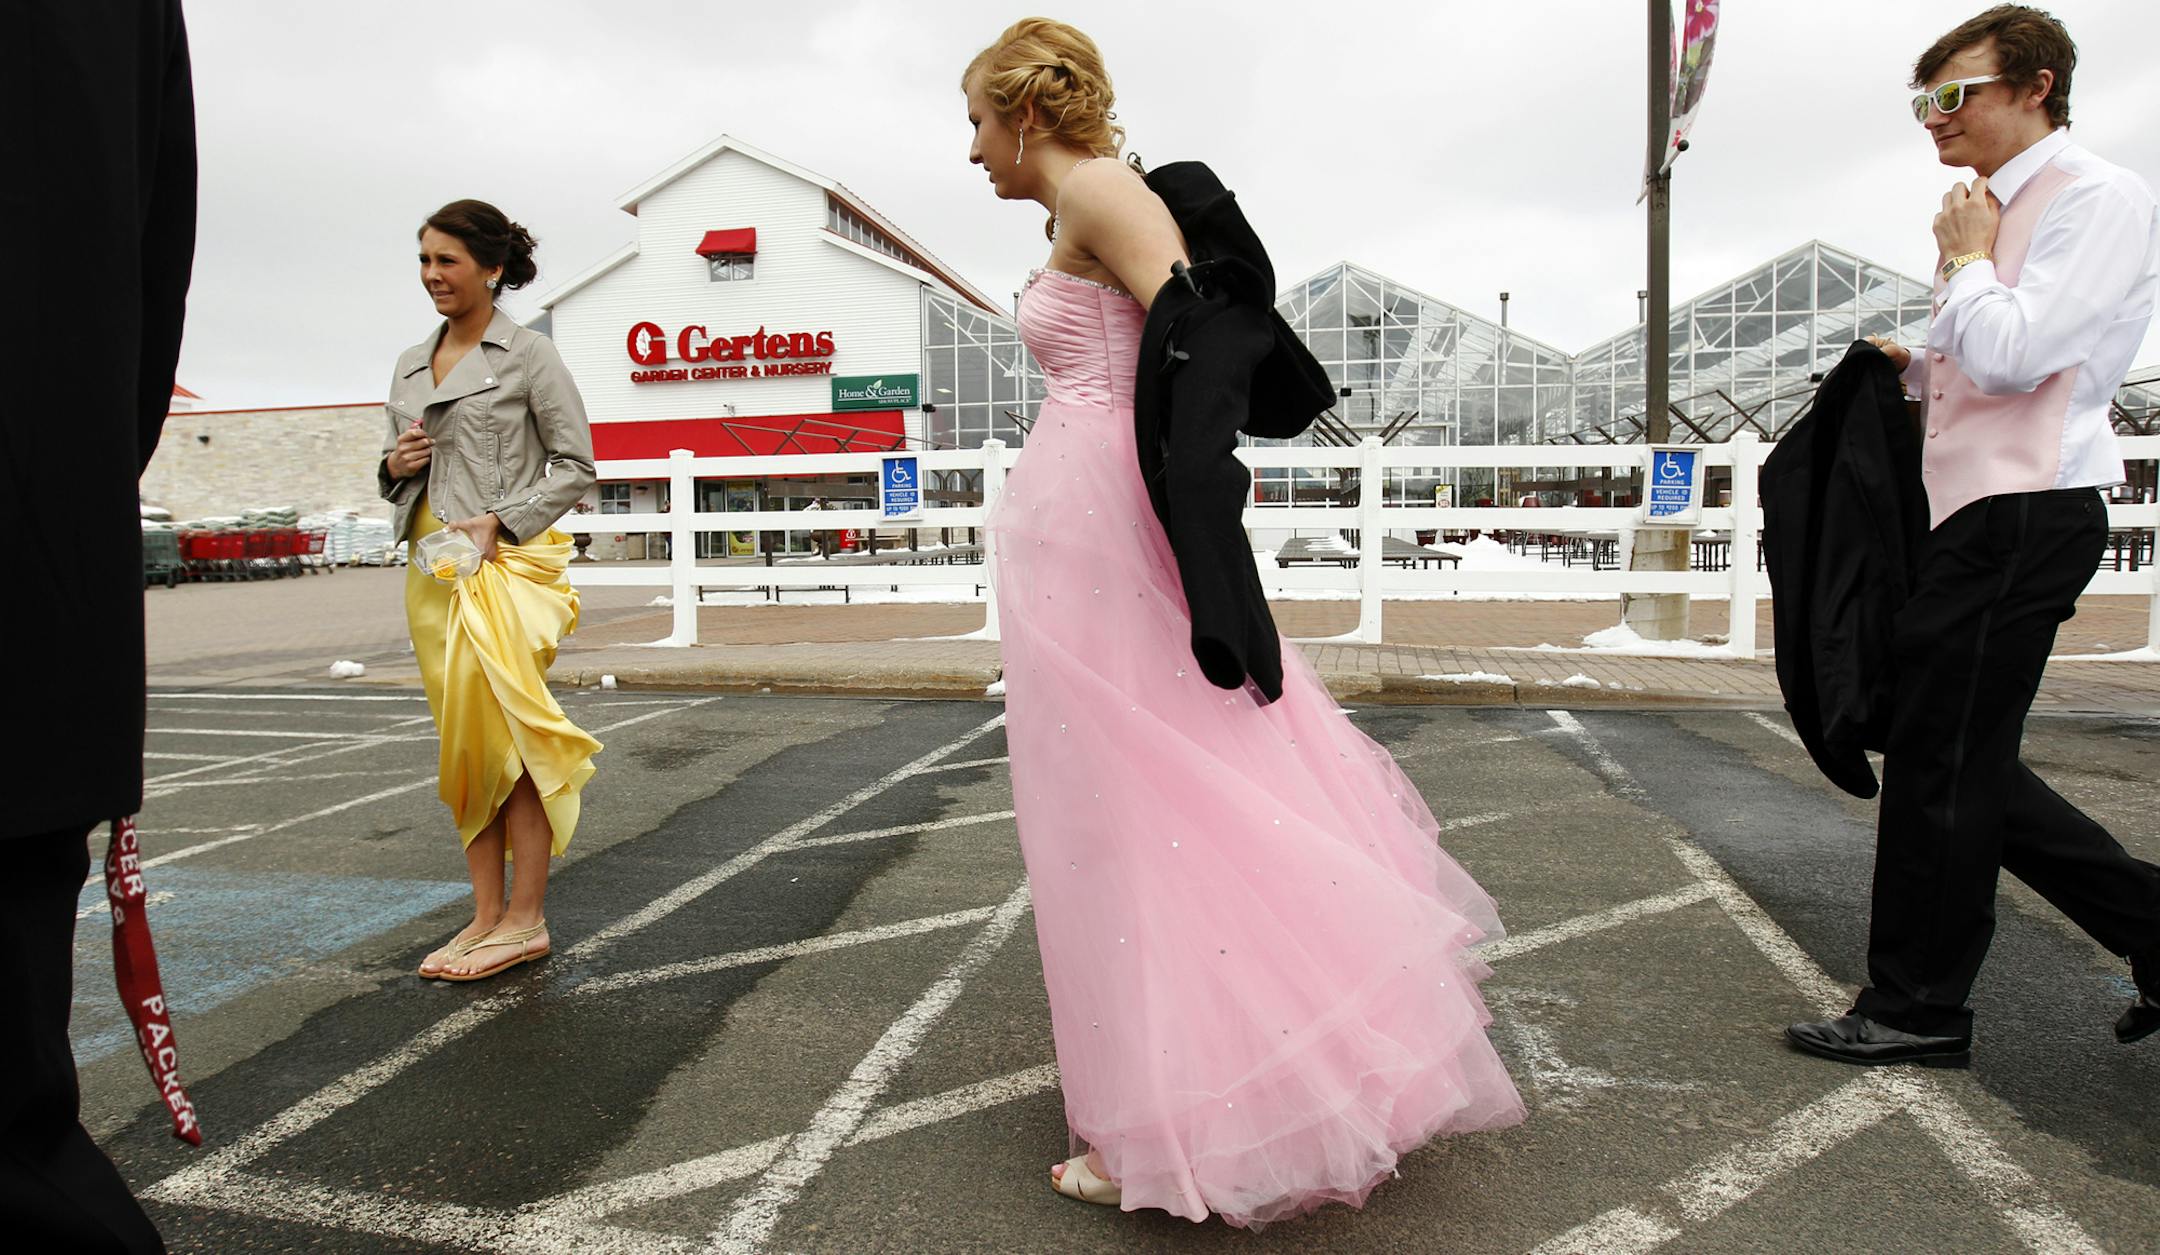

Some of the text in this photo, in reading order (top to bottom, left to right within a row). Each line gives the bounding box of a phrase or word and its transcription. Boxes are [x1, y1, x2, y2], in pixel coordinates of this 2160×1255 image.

[677, 325, 836, 363] Gertens
[631, 361, 832, 384] GARDEN CENTER & NURSERY
[838, 384, 910, 399] Home & Garden
[142, 994, 195, 1134] PACKER
